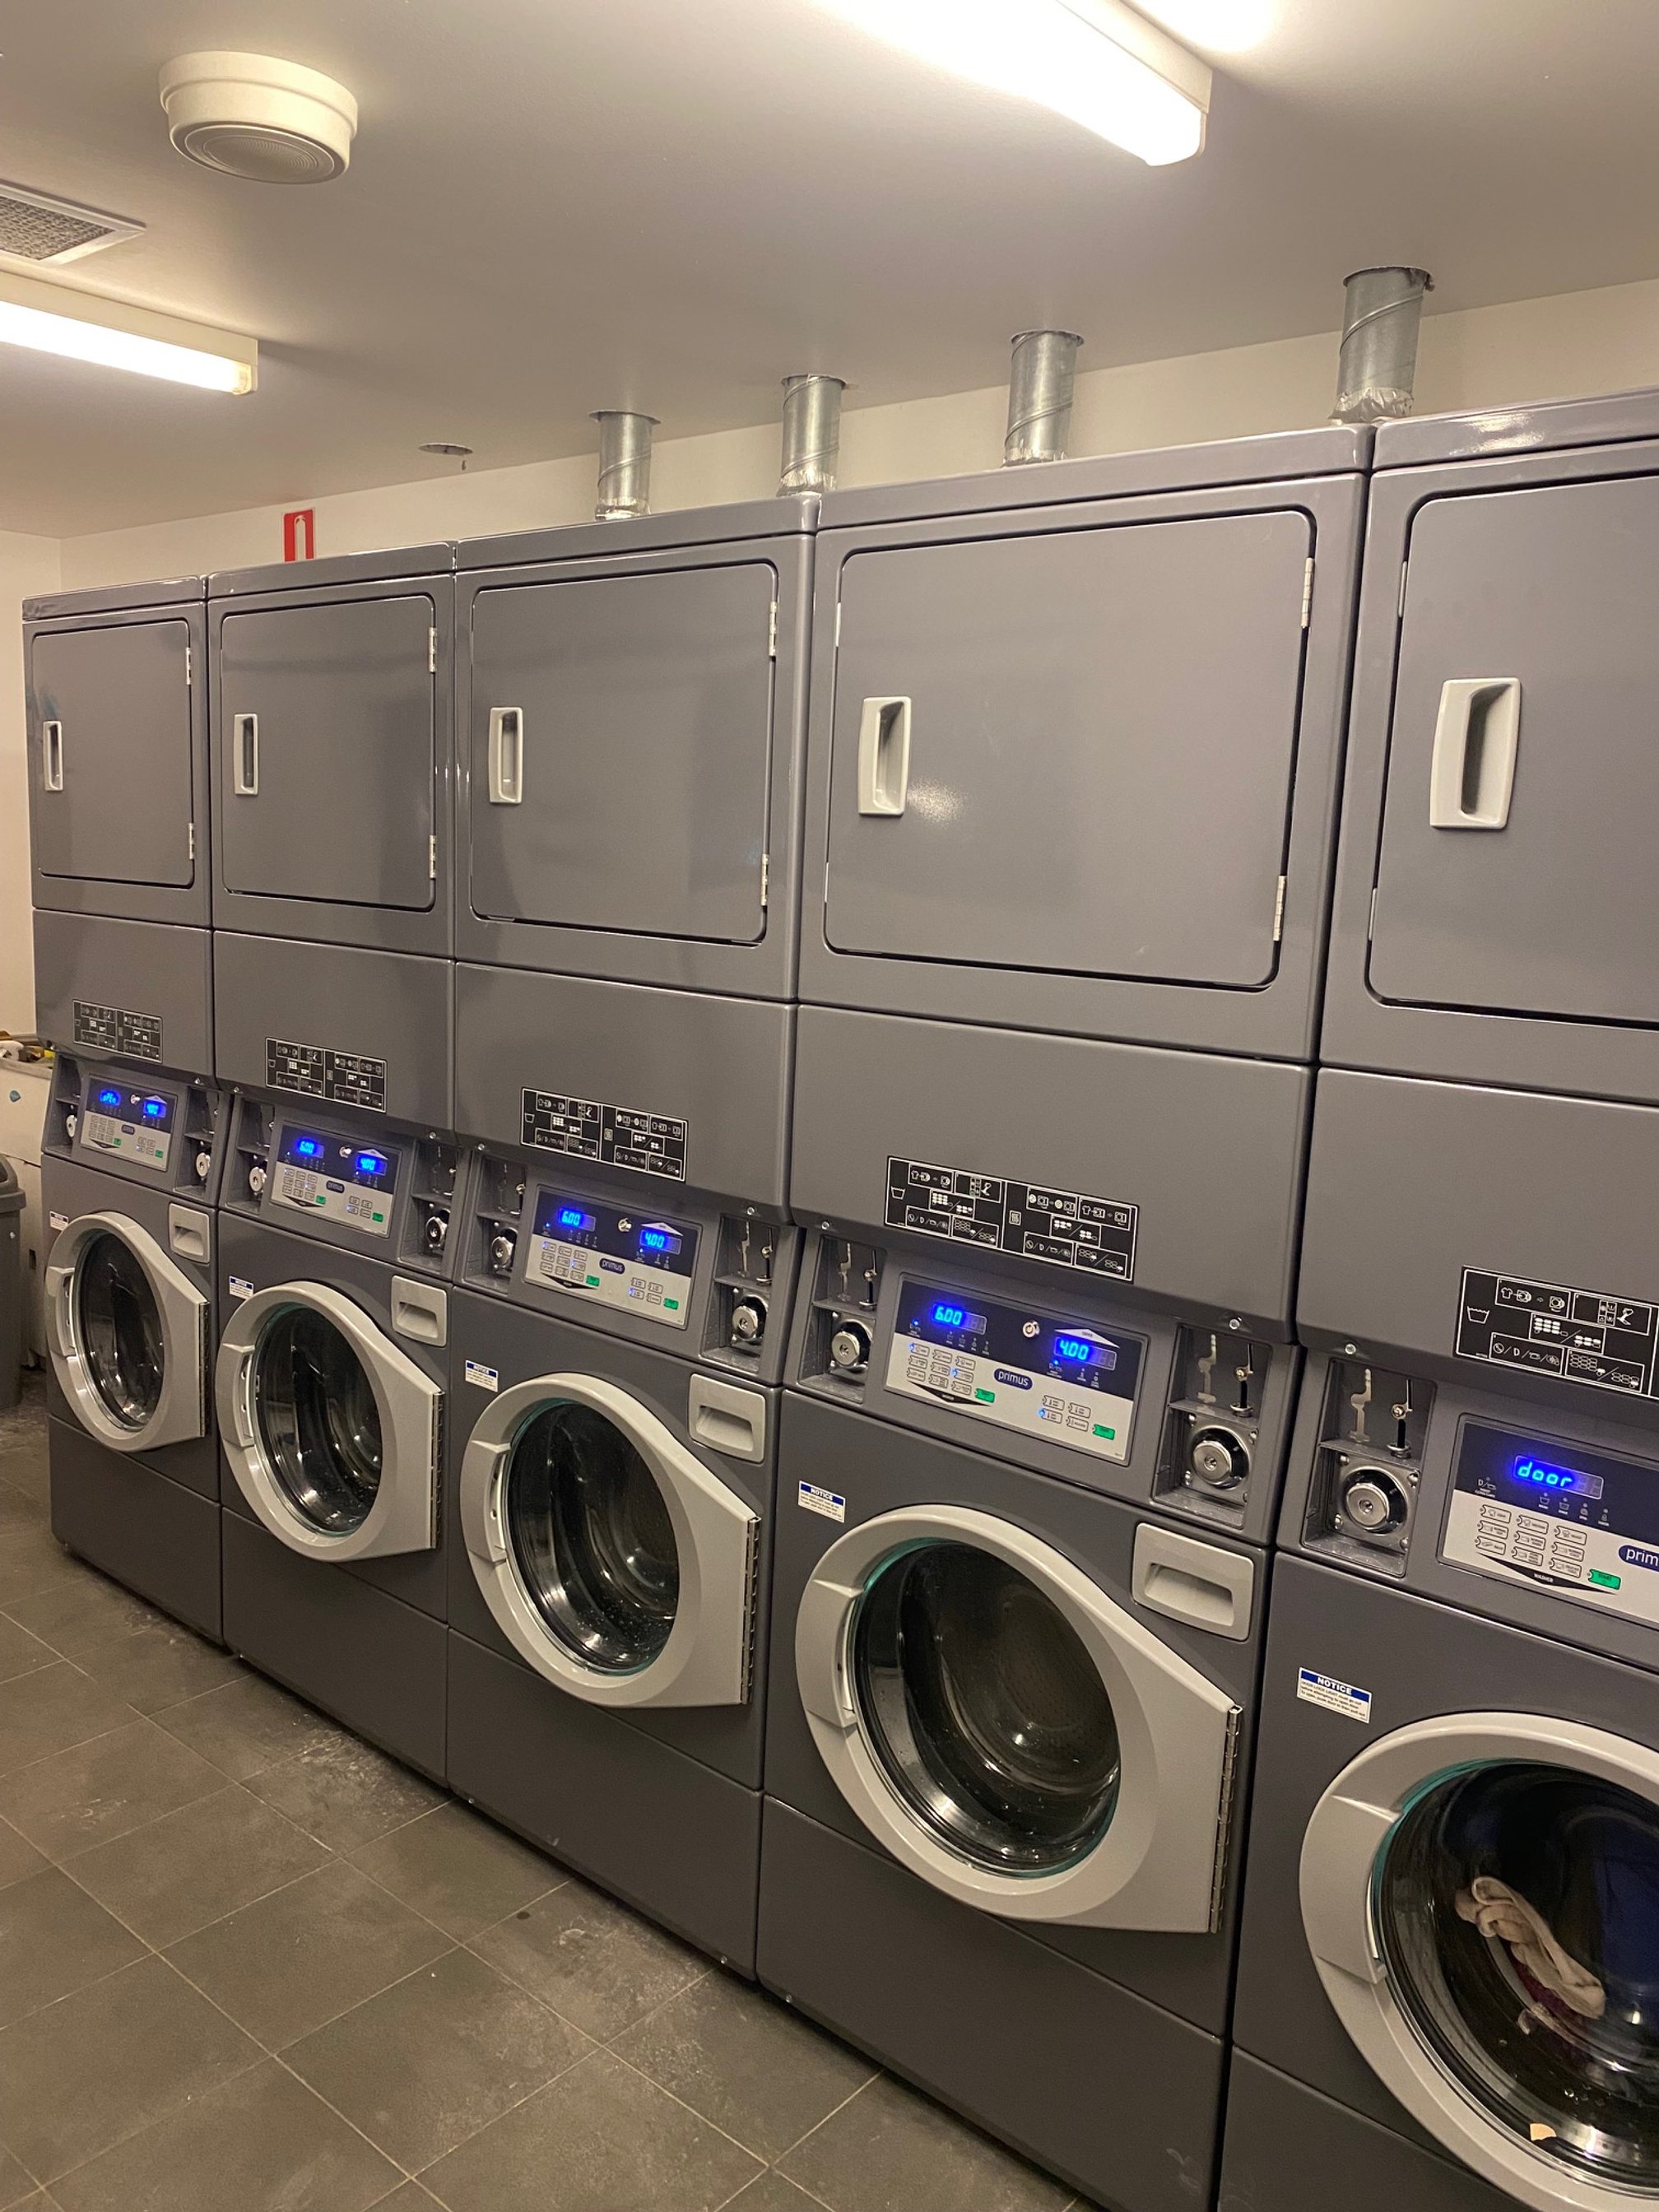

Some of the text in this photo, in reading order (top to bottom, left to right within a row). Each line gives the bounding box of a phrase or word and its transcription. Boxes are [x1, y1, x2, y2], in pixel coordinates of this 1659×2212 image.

[561, 1211, 581, 1225] 6.00
[644, 1232, 665, 1248] 4.00
[934, 1305, 963, 1326] 6.00
[1059, 1339, 1090, 1360] 4.00
[997, 1370, 1029, 1387] primus
[1517, 1462, 1573, 1487] door
[811, 1487, 834, 1501] NOTICE
[1317, 1676, 1352, 1695] NOTICE
